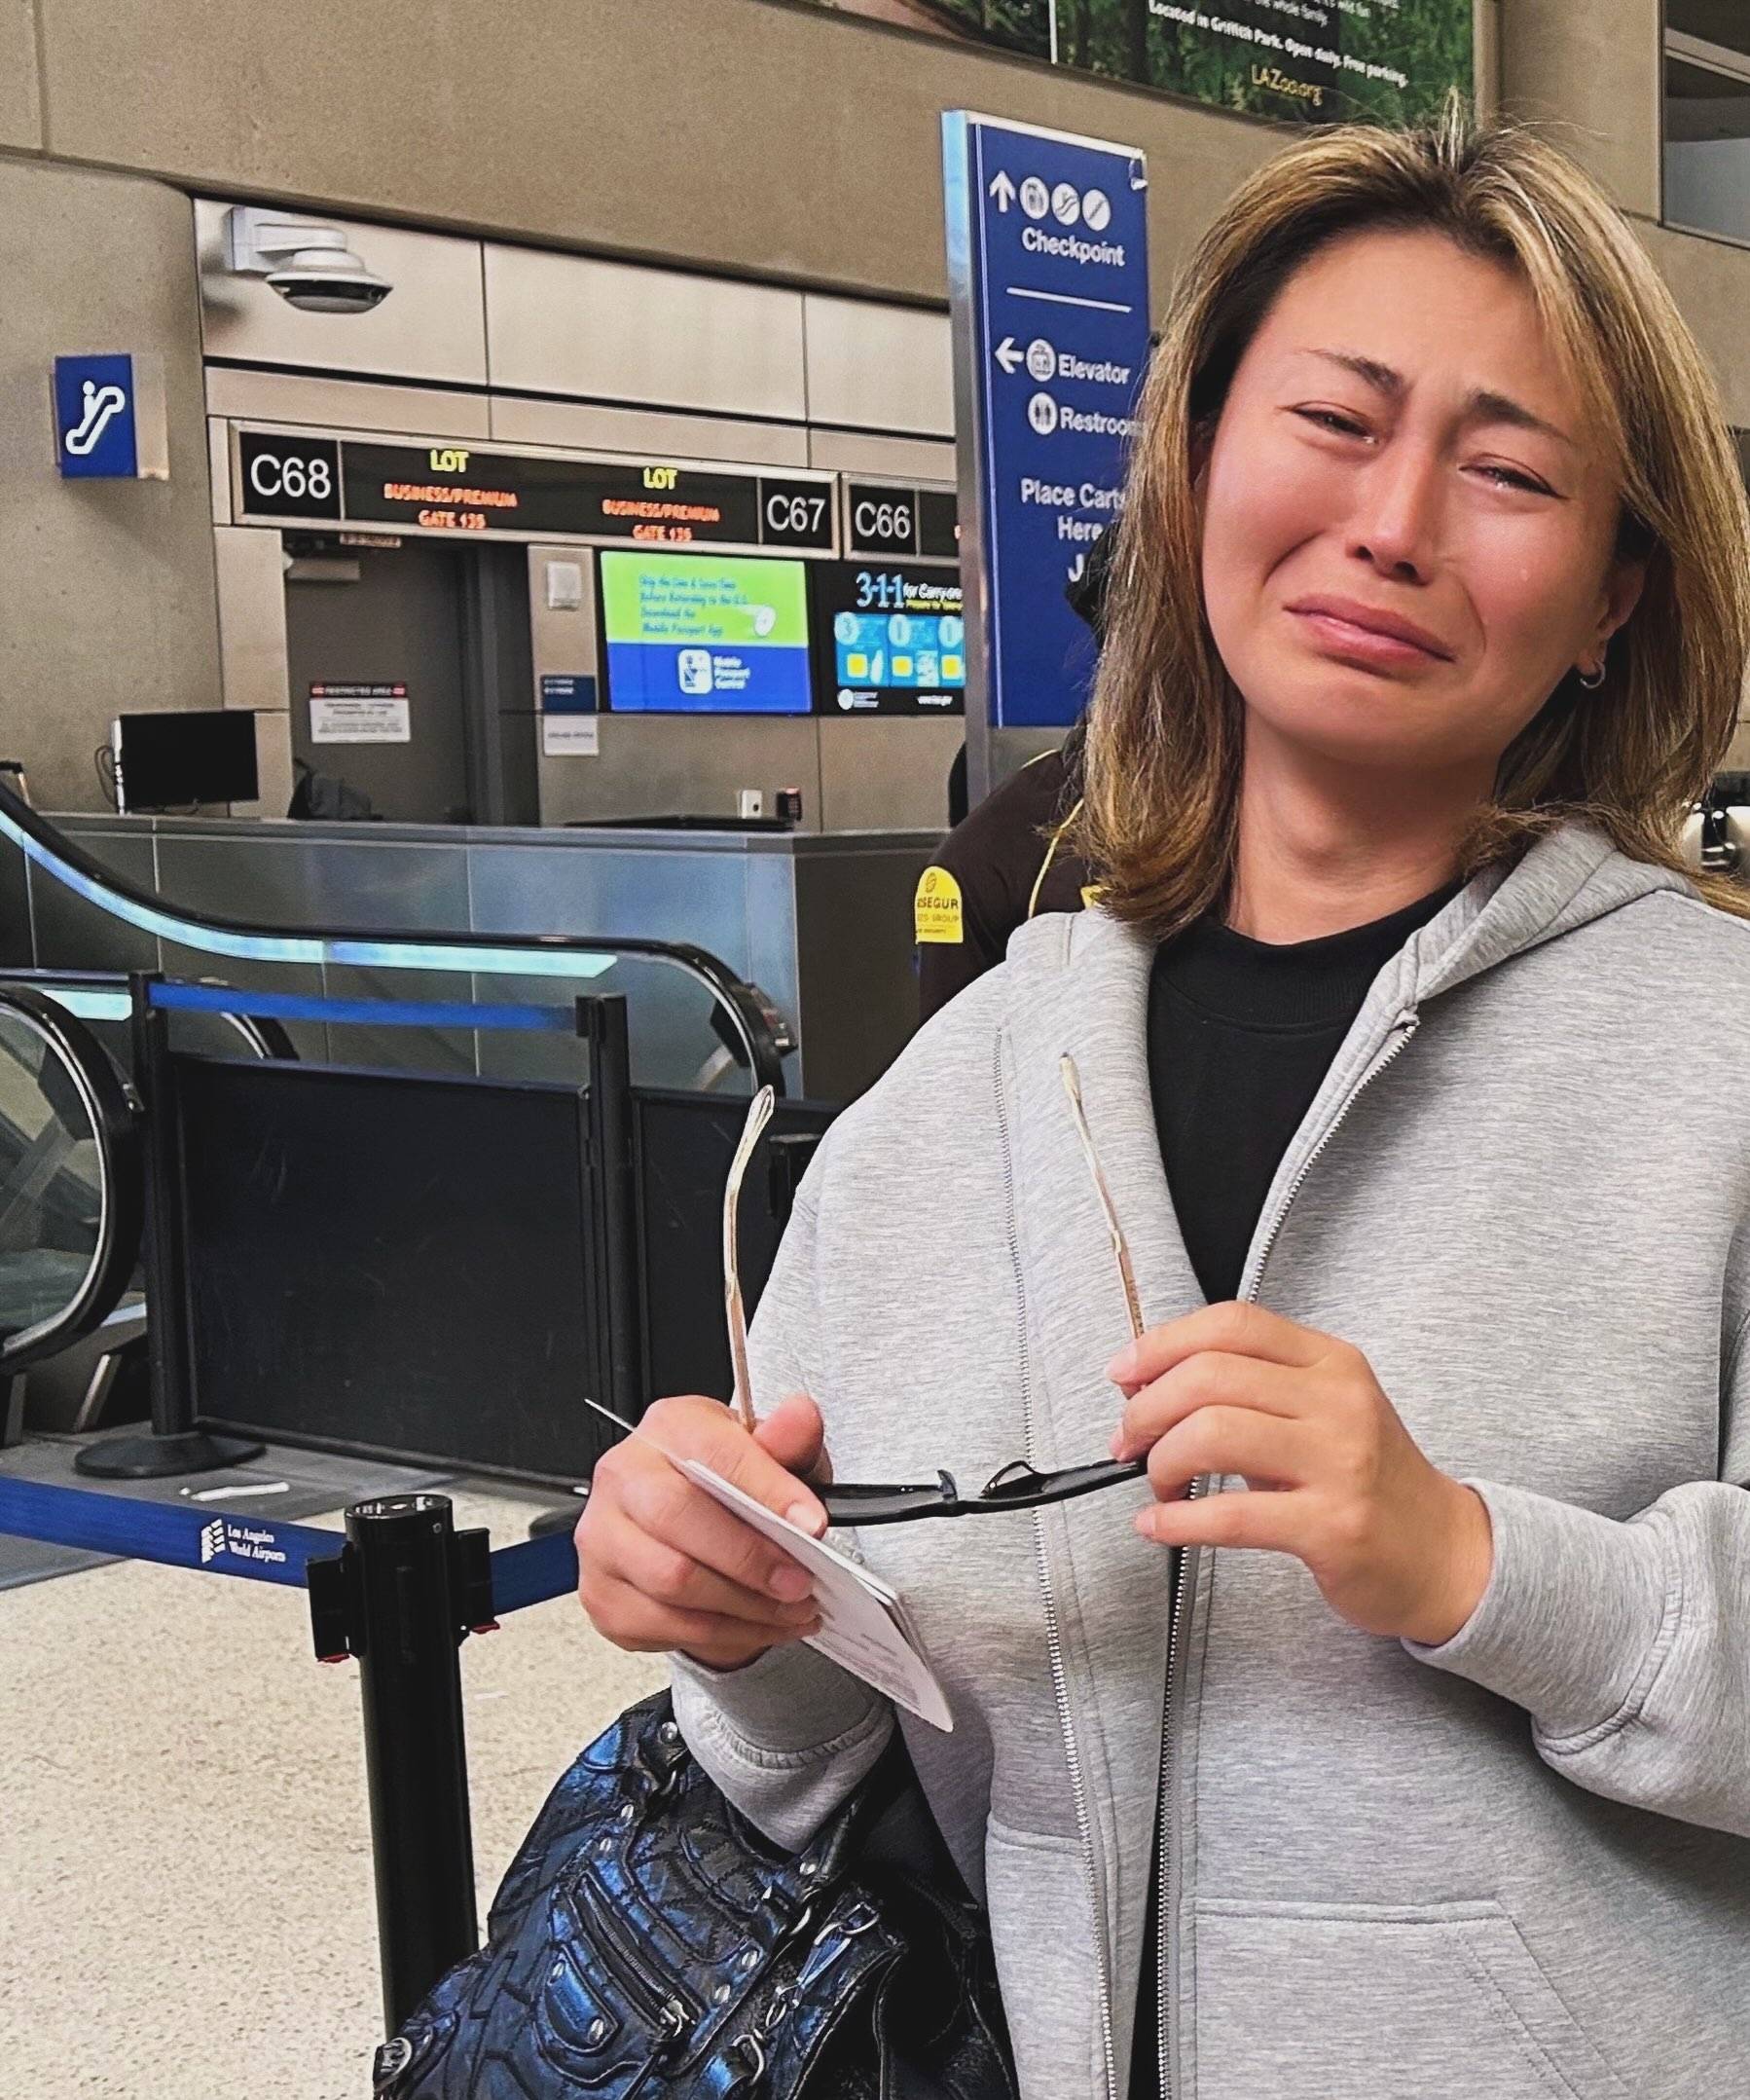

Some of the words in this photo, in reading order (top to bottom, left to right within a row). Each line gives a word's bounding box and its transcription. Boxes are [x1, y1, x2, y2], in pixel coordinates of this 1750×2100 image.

[1148, 0, 1196, 25] Located
[1197, 14, 1210, 29] in
[1211, 17, 1254, 41] Griffith
[1285, 38, 1314, 58] Open
[1343, 55, 1366, 73] Free
[1022, 226, 1125, 267] Checkpoint
[1058, 353, 1130, 385] Elevator
[429, 449, 470, 473] LOT
[250, 454, 332, 499] C68
[642, 467, 678, 490] LOT
[383, 483, 518, 507] BUSINESS/PREMIUM
[1021, 477, 1076, 506] Place
[419, 509, 456, 528] GATE
[602, 498, 720, 523] BUSINESS/PREMIUM
[766, 495, 826, 534] C67
[855, 500, 912, 539] C66
[633, 524, 667, 541] GATE
[1058, 515, 1103, 541] Here
[856, 571, 905, 608] 3-1-1
[228, 1524, 241, 1538] Los
[242, 1528, 274, 1544] Angeles
[229, 1541, 251, 1557] World
[252, 1546, 286, 1563] Airports
